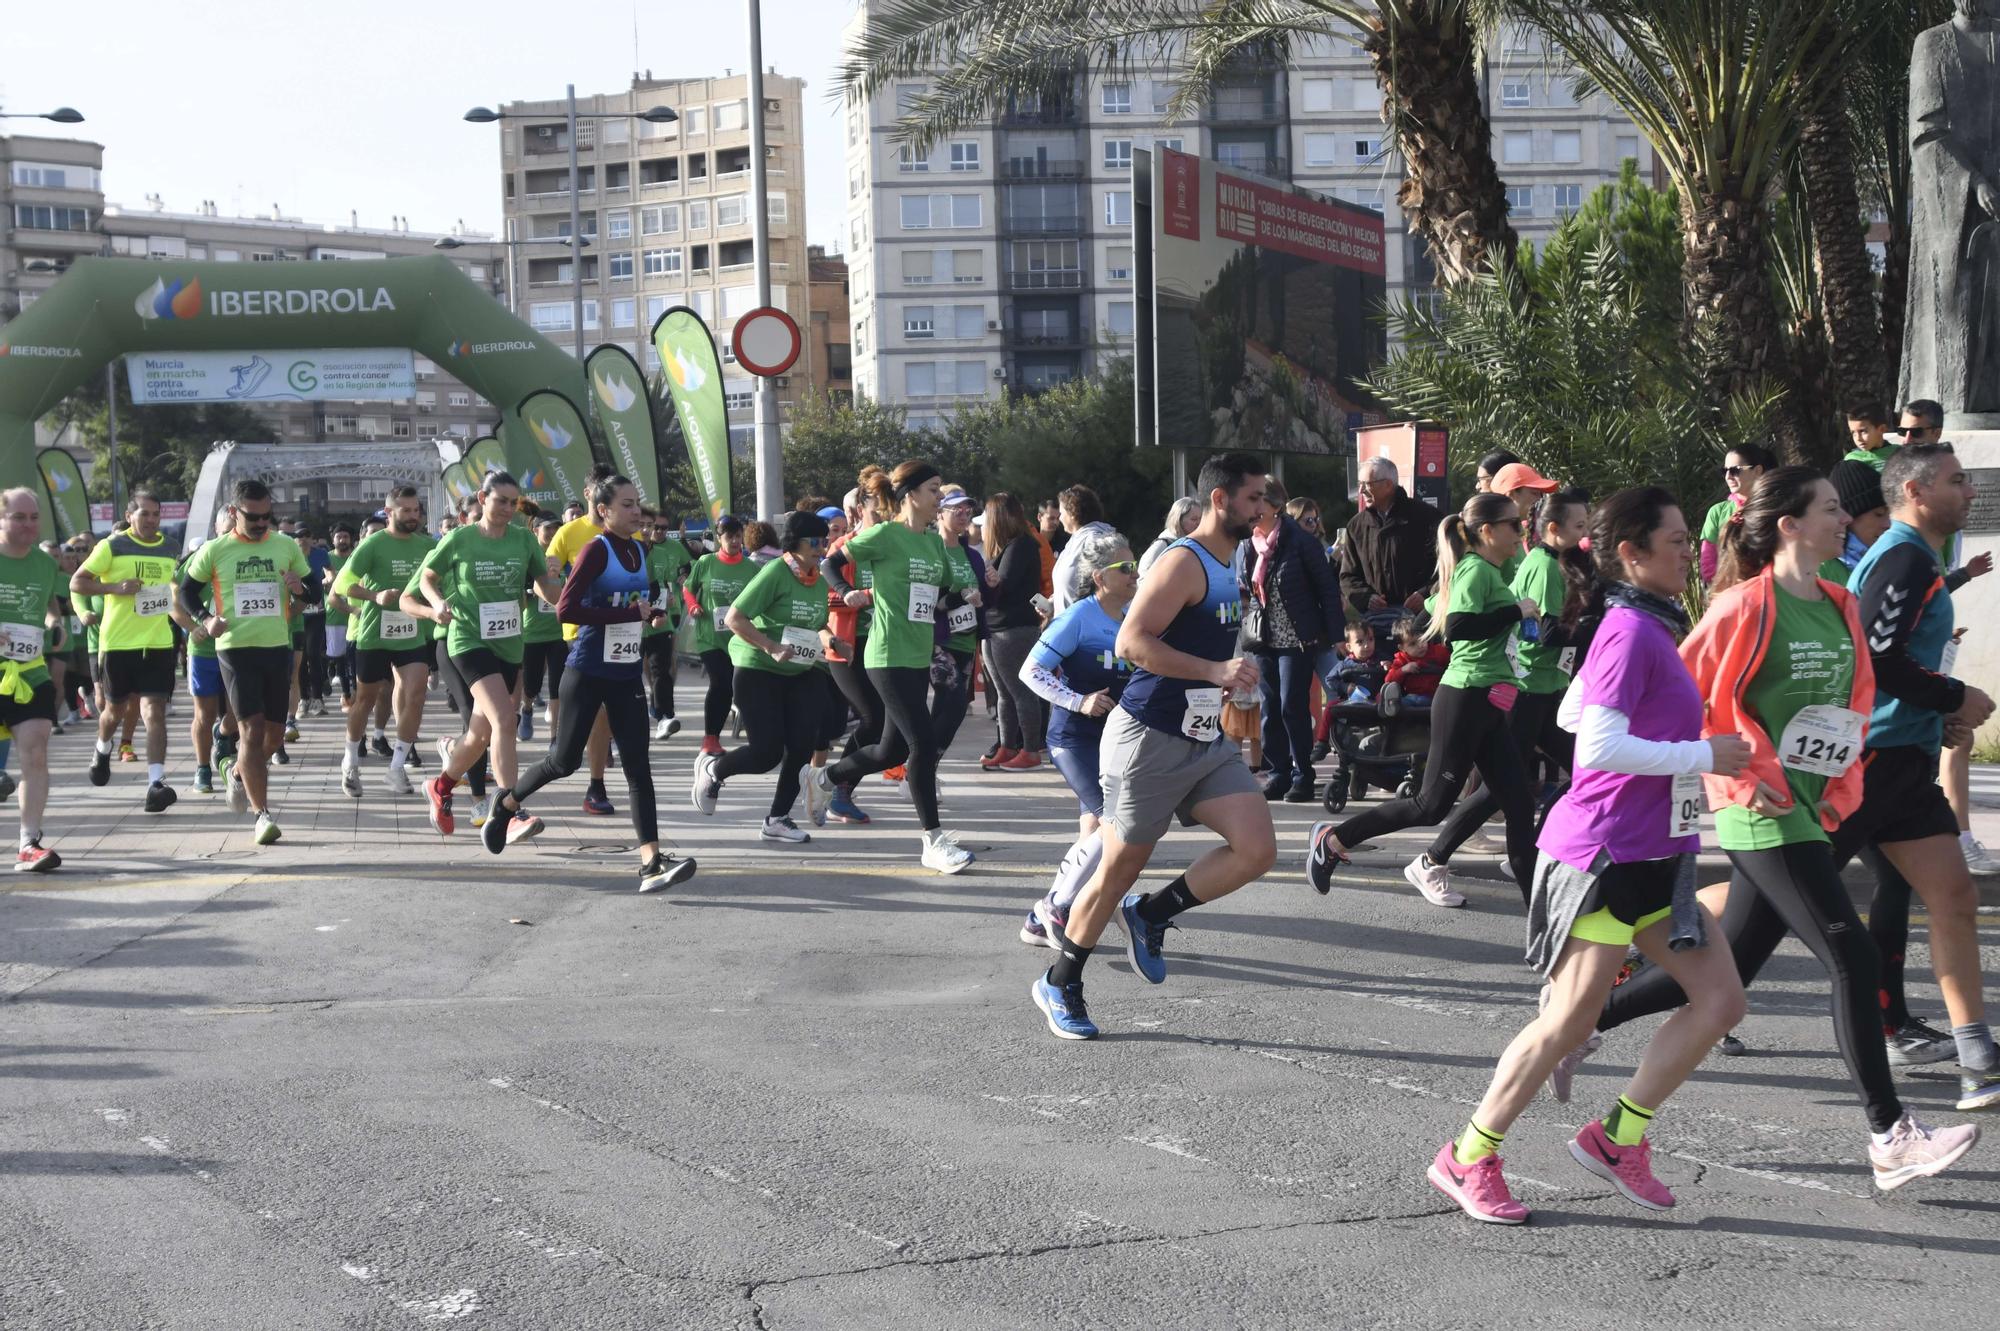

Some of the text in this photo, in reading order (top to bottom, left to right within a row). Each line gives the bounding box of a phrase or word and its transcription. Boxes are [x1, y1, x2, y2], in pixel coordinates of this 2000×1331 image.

[1220, 182, 1255, 212] MURCIA
[1220, 208, 1236, 232] RIO
[1287, 208, 1297, 222] DE
[1298, 210, 1348, 237] REVEGETACIÓN
[1348, 226, 1354, 237] Y
[1354, 227, 1380, 245] MEJORA
[1261, 220, 1271, 235] DE
[1272, 223, 1286, 240] LOS
[1327, 238, 1340, 253] DEL
[210, 287, 396, 316] IBERDROLA
[10, 345, 82, 358] IBERDROLA
[471, 340, 536, 355] IBERDROLA
[145, 360, 184, 369] Murcia
[146, 368, 207, 379] en marcha
[323, 372, 351, 380] contra
[146, 380, 184, 389] contra
[147, 389, 159, 398] el
[142, 598, 168, 610] 2346
[242, 599, 275, 610] 2335
[387, 623, 413, 634] 2418
[488, 618, 517, 631] 2210
[7, 641, 38, 655] 1261
[1789, 640, 1823, 651] Murcia
[1791, 660, 1822, 670] contra
[1791, 670, 1802, 680] el
[1796, 735, 1850, 764] 1214
